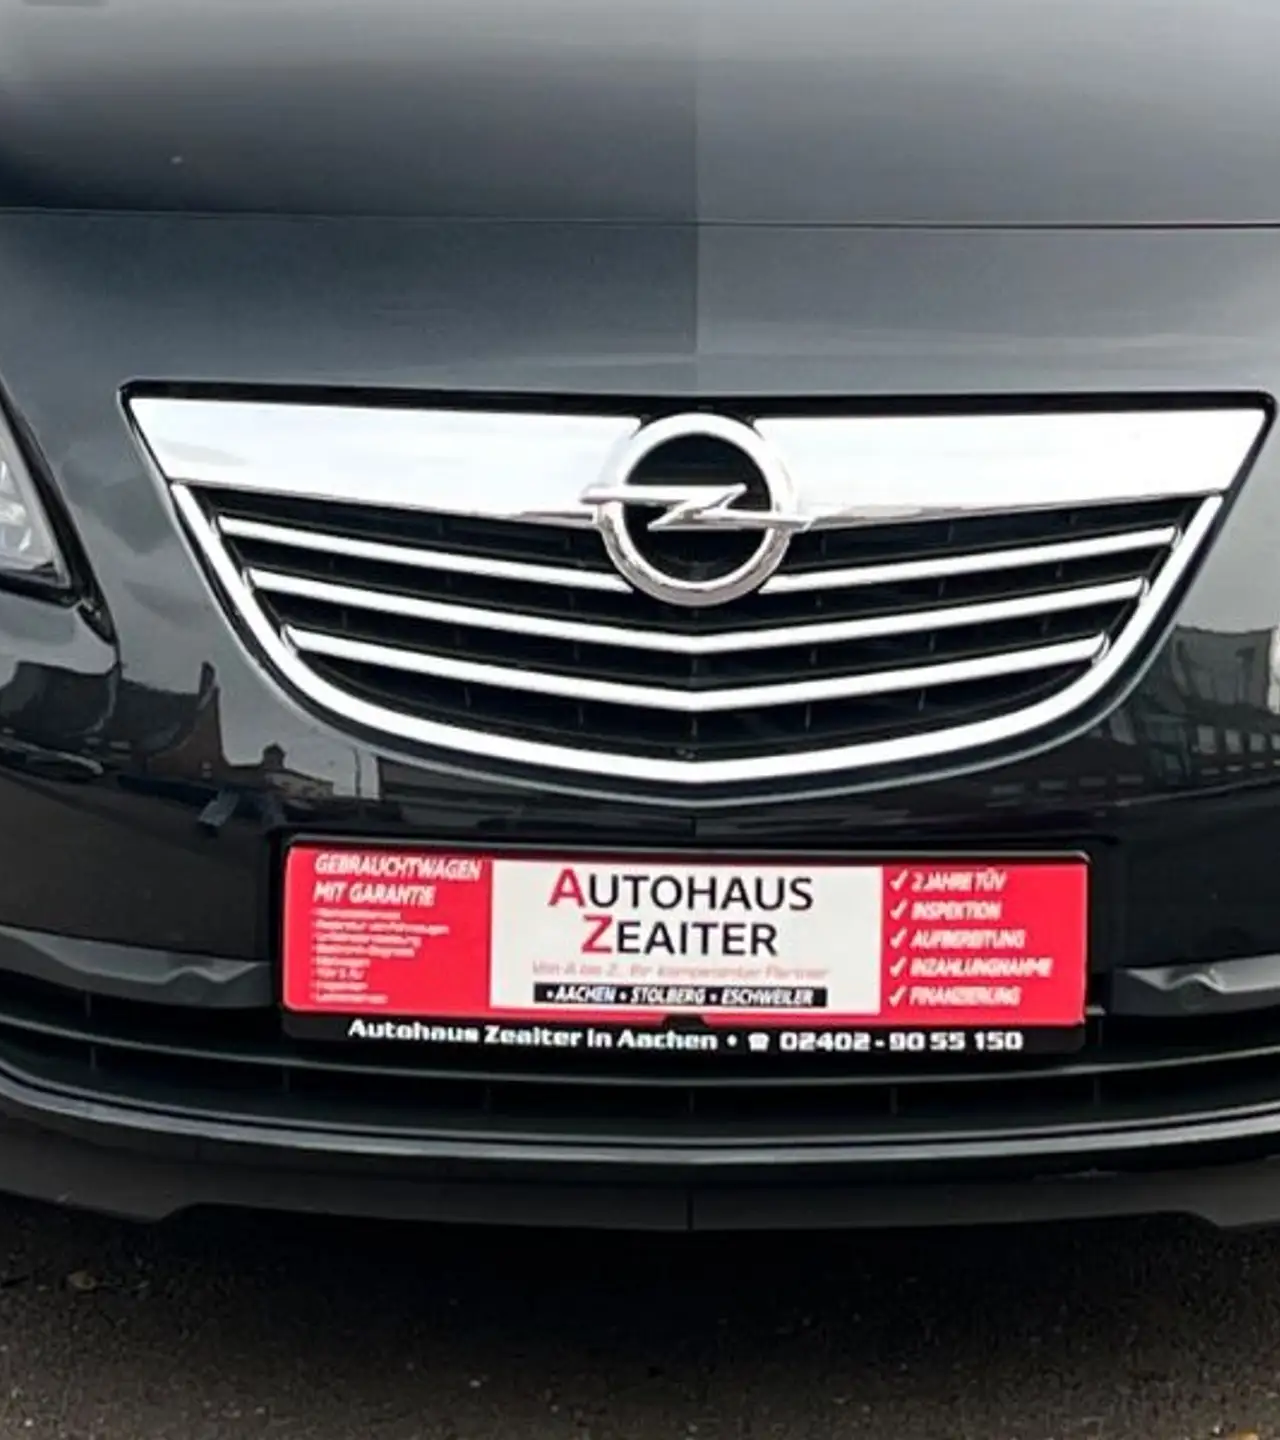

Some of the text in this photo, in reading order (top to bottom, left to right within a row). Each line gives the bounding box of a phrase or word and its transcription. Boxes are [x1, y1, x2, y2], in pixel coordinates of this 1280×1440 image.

[314, 853, 483, 881] GEBRAUCHTWAGEN
[313, 880, 436, 908] MIT GARANTIE
[911, 900, 1003, 920] INSPEKTION
[910, 928, 1026, 949] AUFBEREITUNG
[555, 985, 813, 1005] AACHEN STOLBERG ESCHWEILER
[909, 985, 1022, 1006] FINANZIERUNG
[347, 1018, 479, 1044] Autohaus
[484, 1024, 582, 1048] Zeaiter
[616, 1026, 718, 1051] Aachen
[780, 1031, 870, 1052] 02402
[889, 1031, 925, 1051] 90
[929, 1031, 965, 1051] 55
[974, 1031, 1024, 1052] 150
